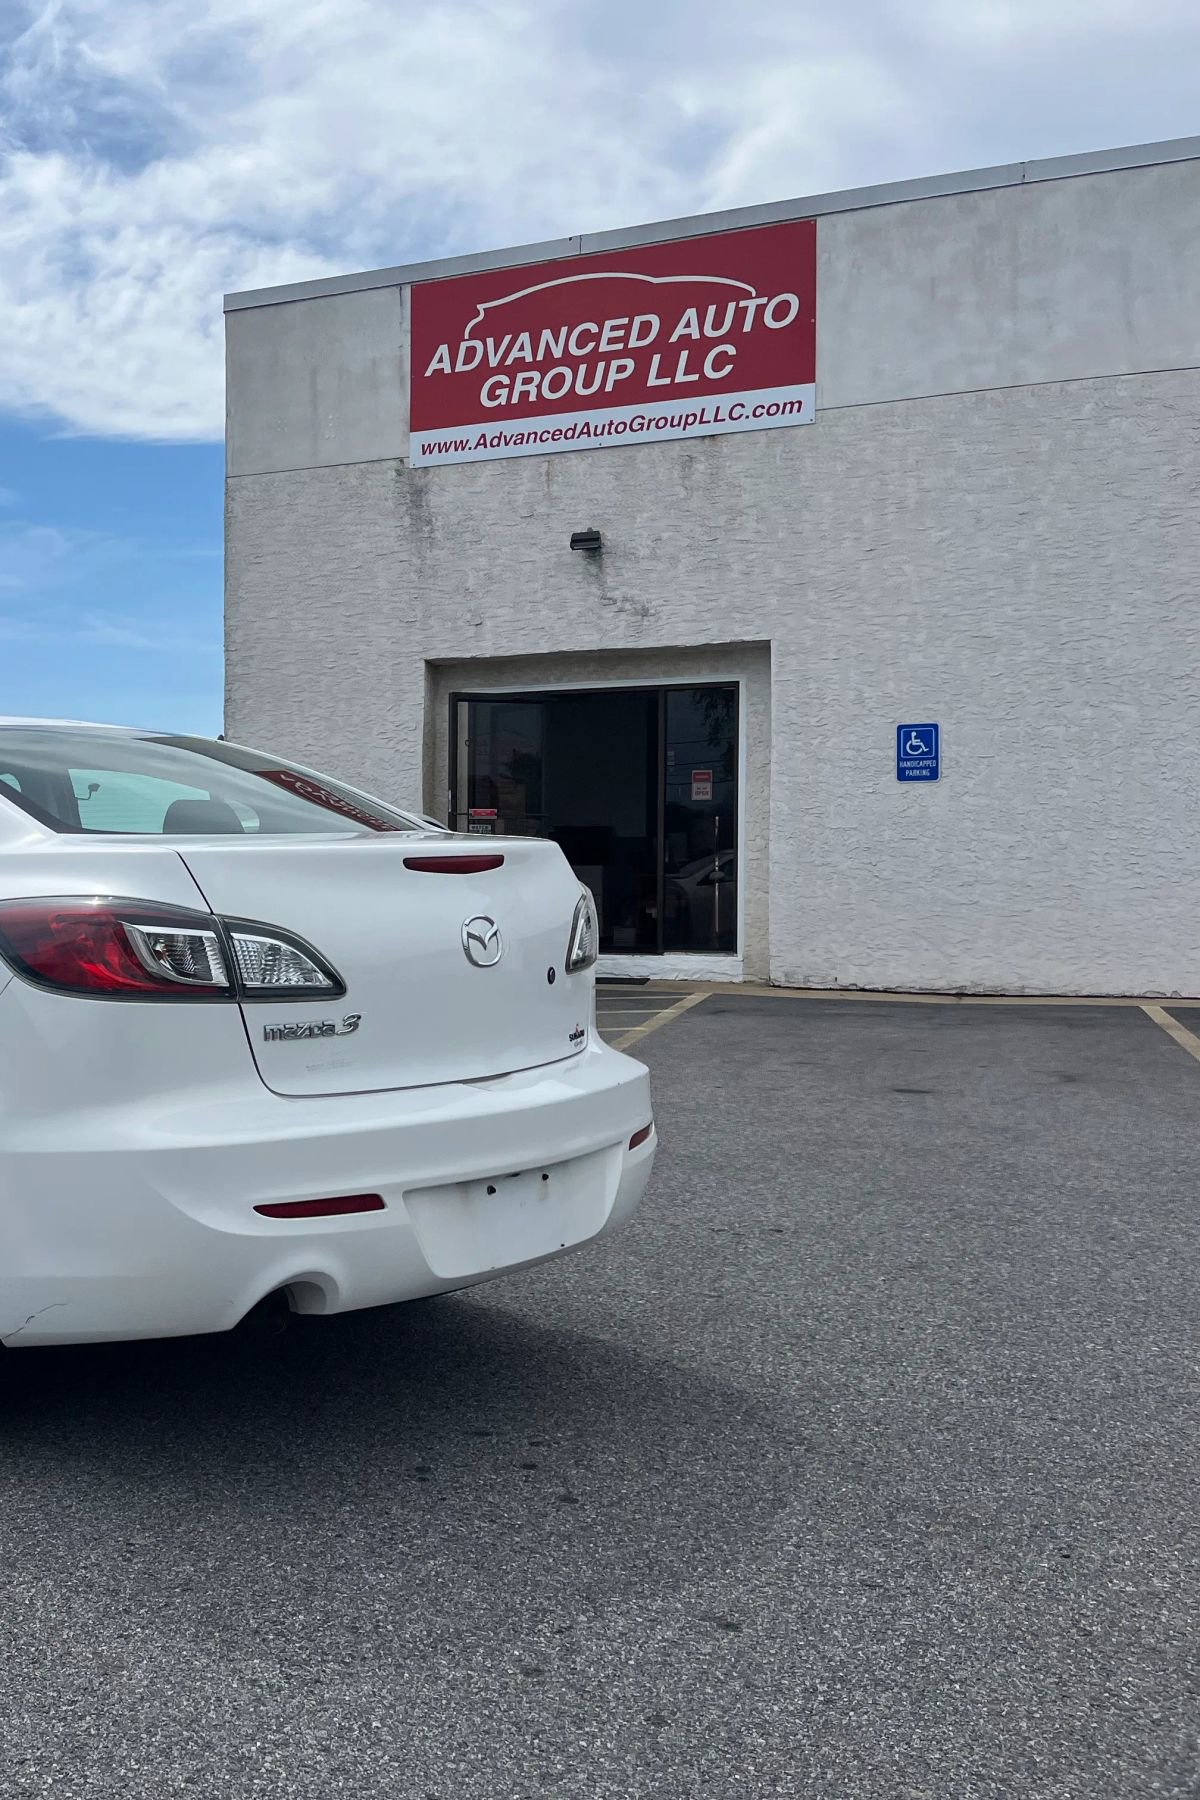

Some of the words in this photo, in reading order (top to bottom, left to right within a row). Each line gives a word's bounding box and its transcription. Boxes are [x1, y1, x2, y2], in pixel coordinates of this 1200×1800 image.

[424, 314, 661, 377] ADVANCED
[668, 293, 799, 343] AUTO
[480, 357, 635, 408] GROUP
[646, 344, 737, 387] LLC
[420, 398, 803, 457] www.AdvancedAutoGroupLLC.com
[899, 760, 936, 768] HANDICAPPED
